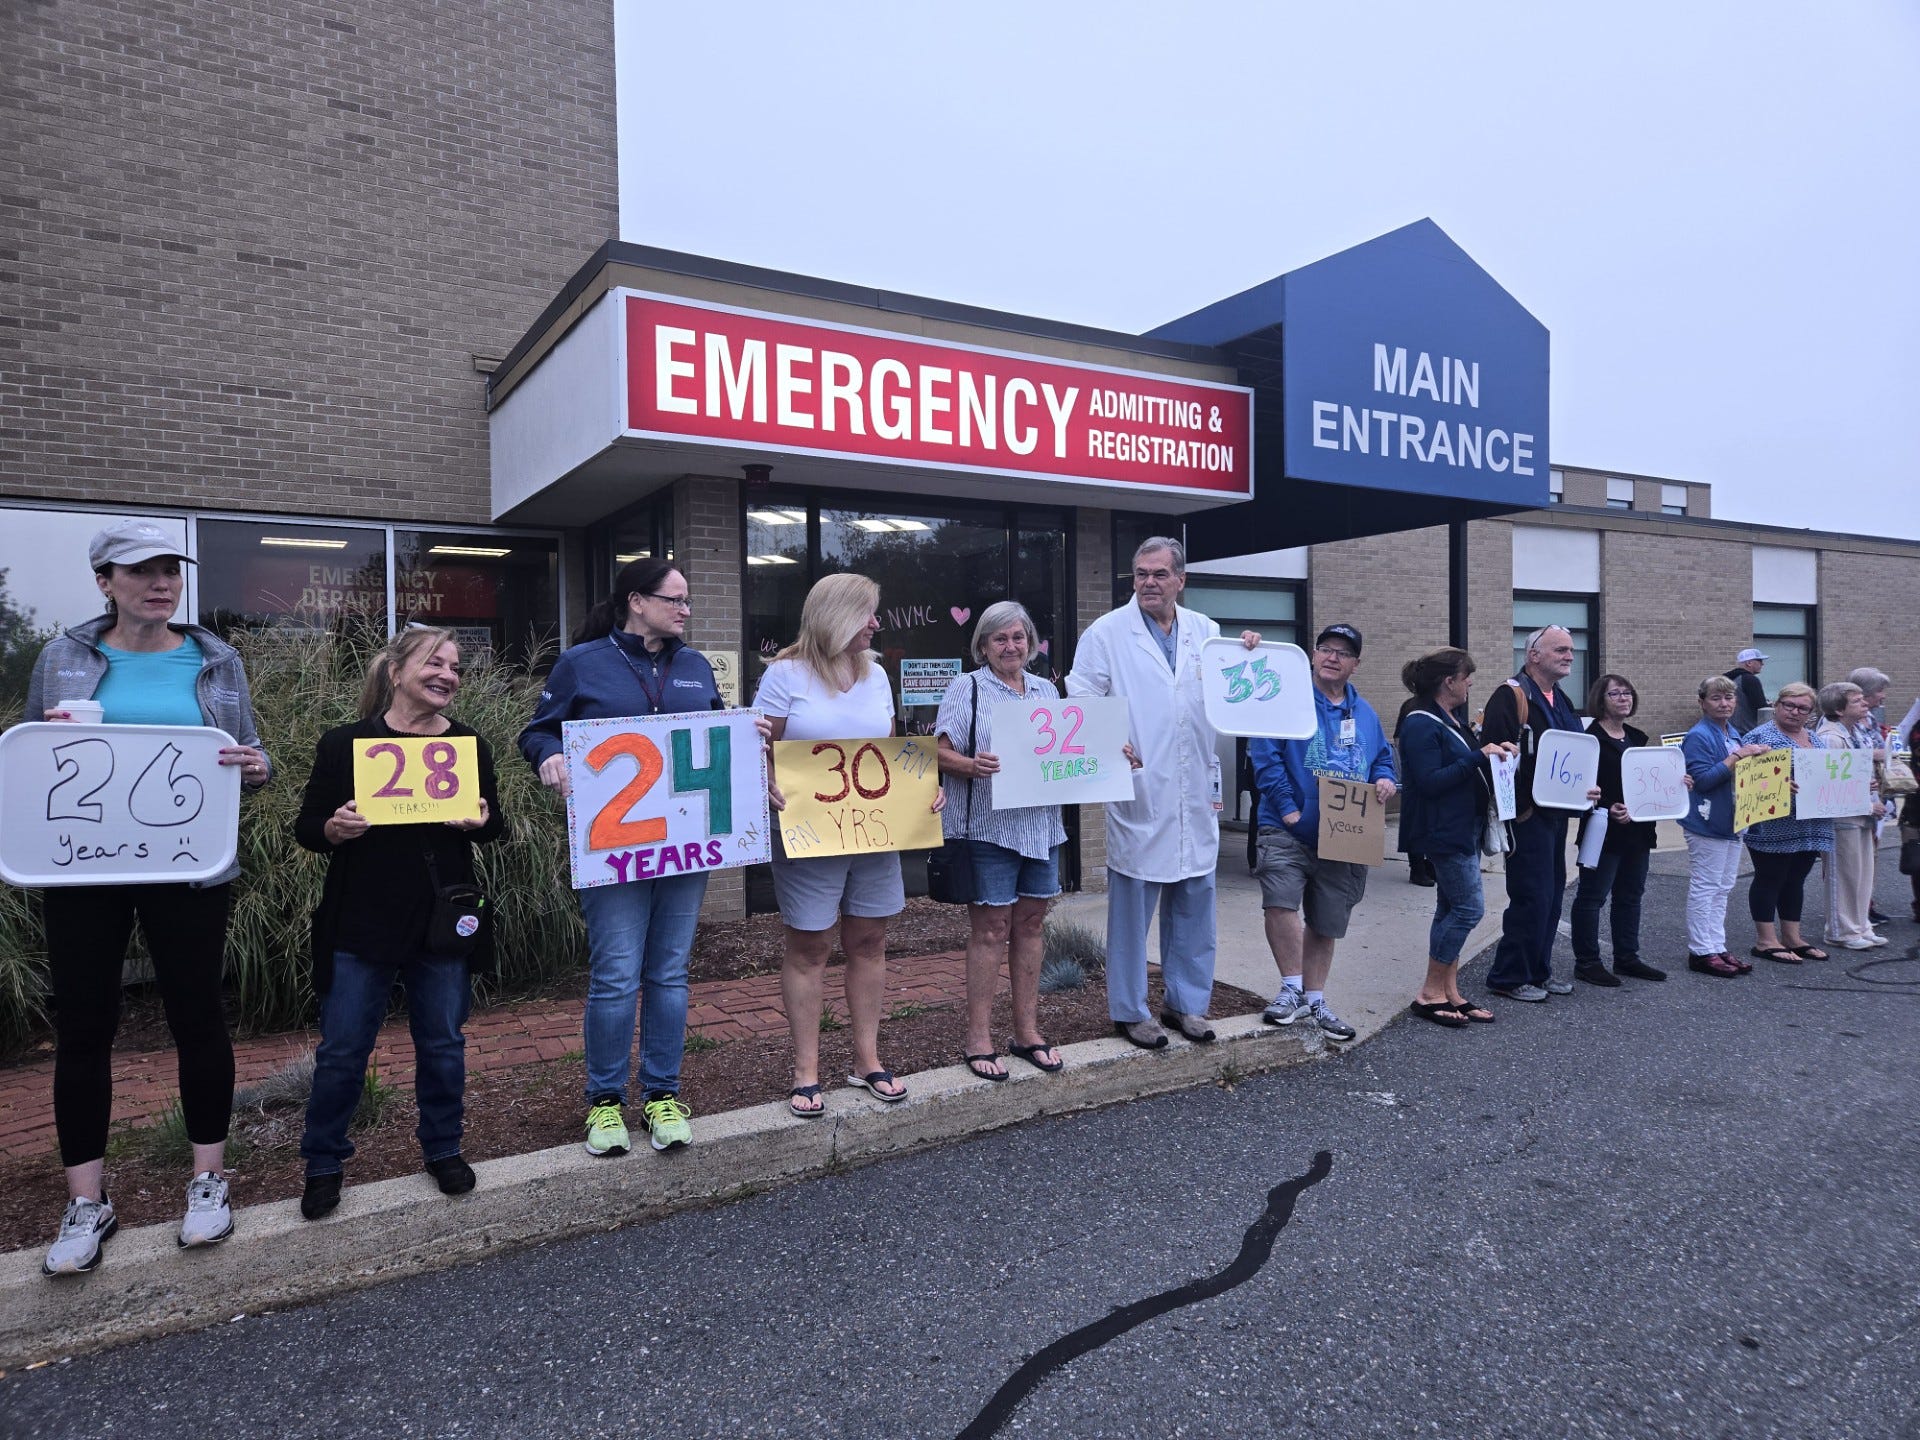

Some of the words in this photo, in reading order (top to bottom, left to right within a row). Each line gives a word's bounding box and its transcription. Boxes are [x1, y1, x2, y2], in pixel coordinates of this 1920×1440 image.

[655, 324, 1080, 459] EMERGENCY
[1374, 343, 1479, 408] MAIN
[1089, 388, 1202, 431] ADMITTING
[1208, 405, 1223, 433] &
[1088, 429, 1233, 472] REGISTRATION
[1313, 400, 1535, 476] ENTRANCE
[309, 565, 437, 589] EMERGNCY
[887, 605, 938, 631] NVMC
[760, 637, 778, 653] We
[904, 679, 918, 687] SAVE
[919, 679, 931, 687] OUR
[571, 729, 593, 754] RN
[1030, 705, 1085, 755] 32
[365, 741, 460, 800] 28
[812, 742, 891, 803] 30
[894, 740, 932, 779] RN
[1041, 756, 1098, 782] YEARS
[1551, 750, 1571, 785] 16
[1825, 751, 1853, 780] 42
[46, 738, 204, 827] 26
[585, 725, 732, 850] 24
[1328, 780, 1368, 818] 34
[1633, 766, 1663, 796] 38
[392, 803, 440, 815] YEARS!!!
[1328, 818, 1364, 838] years
[785, 820, 820, 853] RN
[827, 808, 894, 849] YRS.
[605, 840, 723, 883] YEARS
